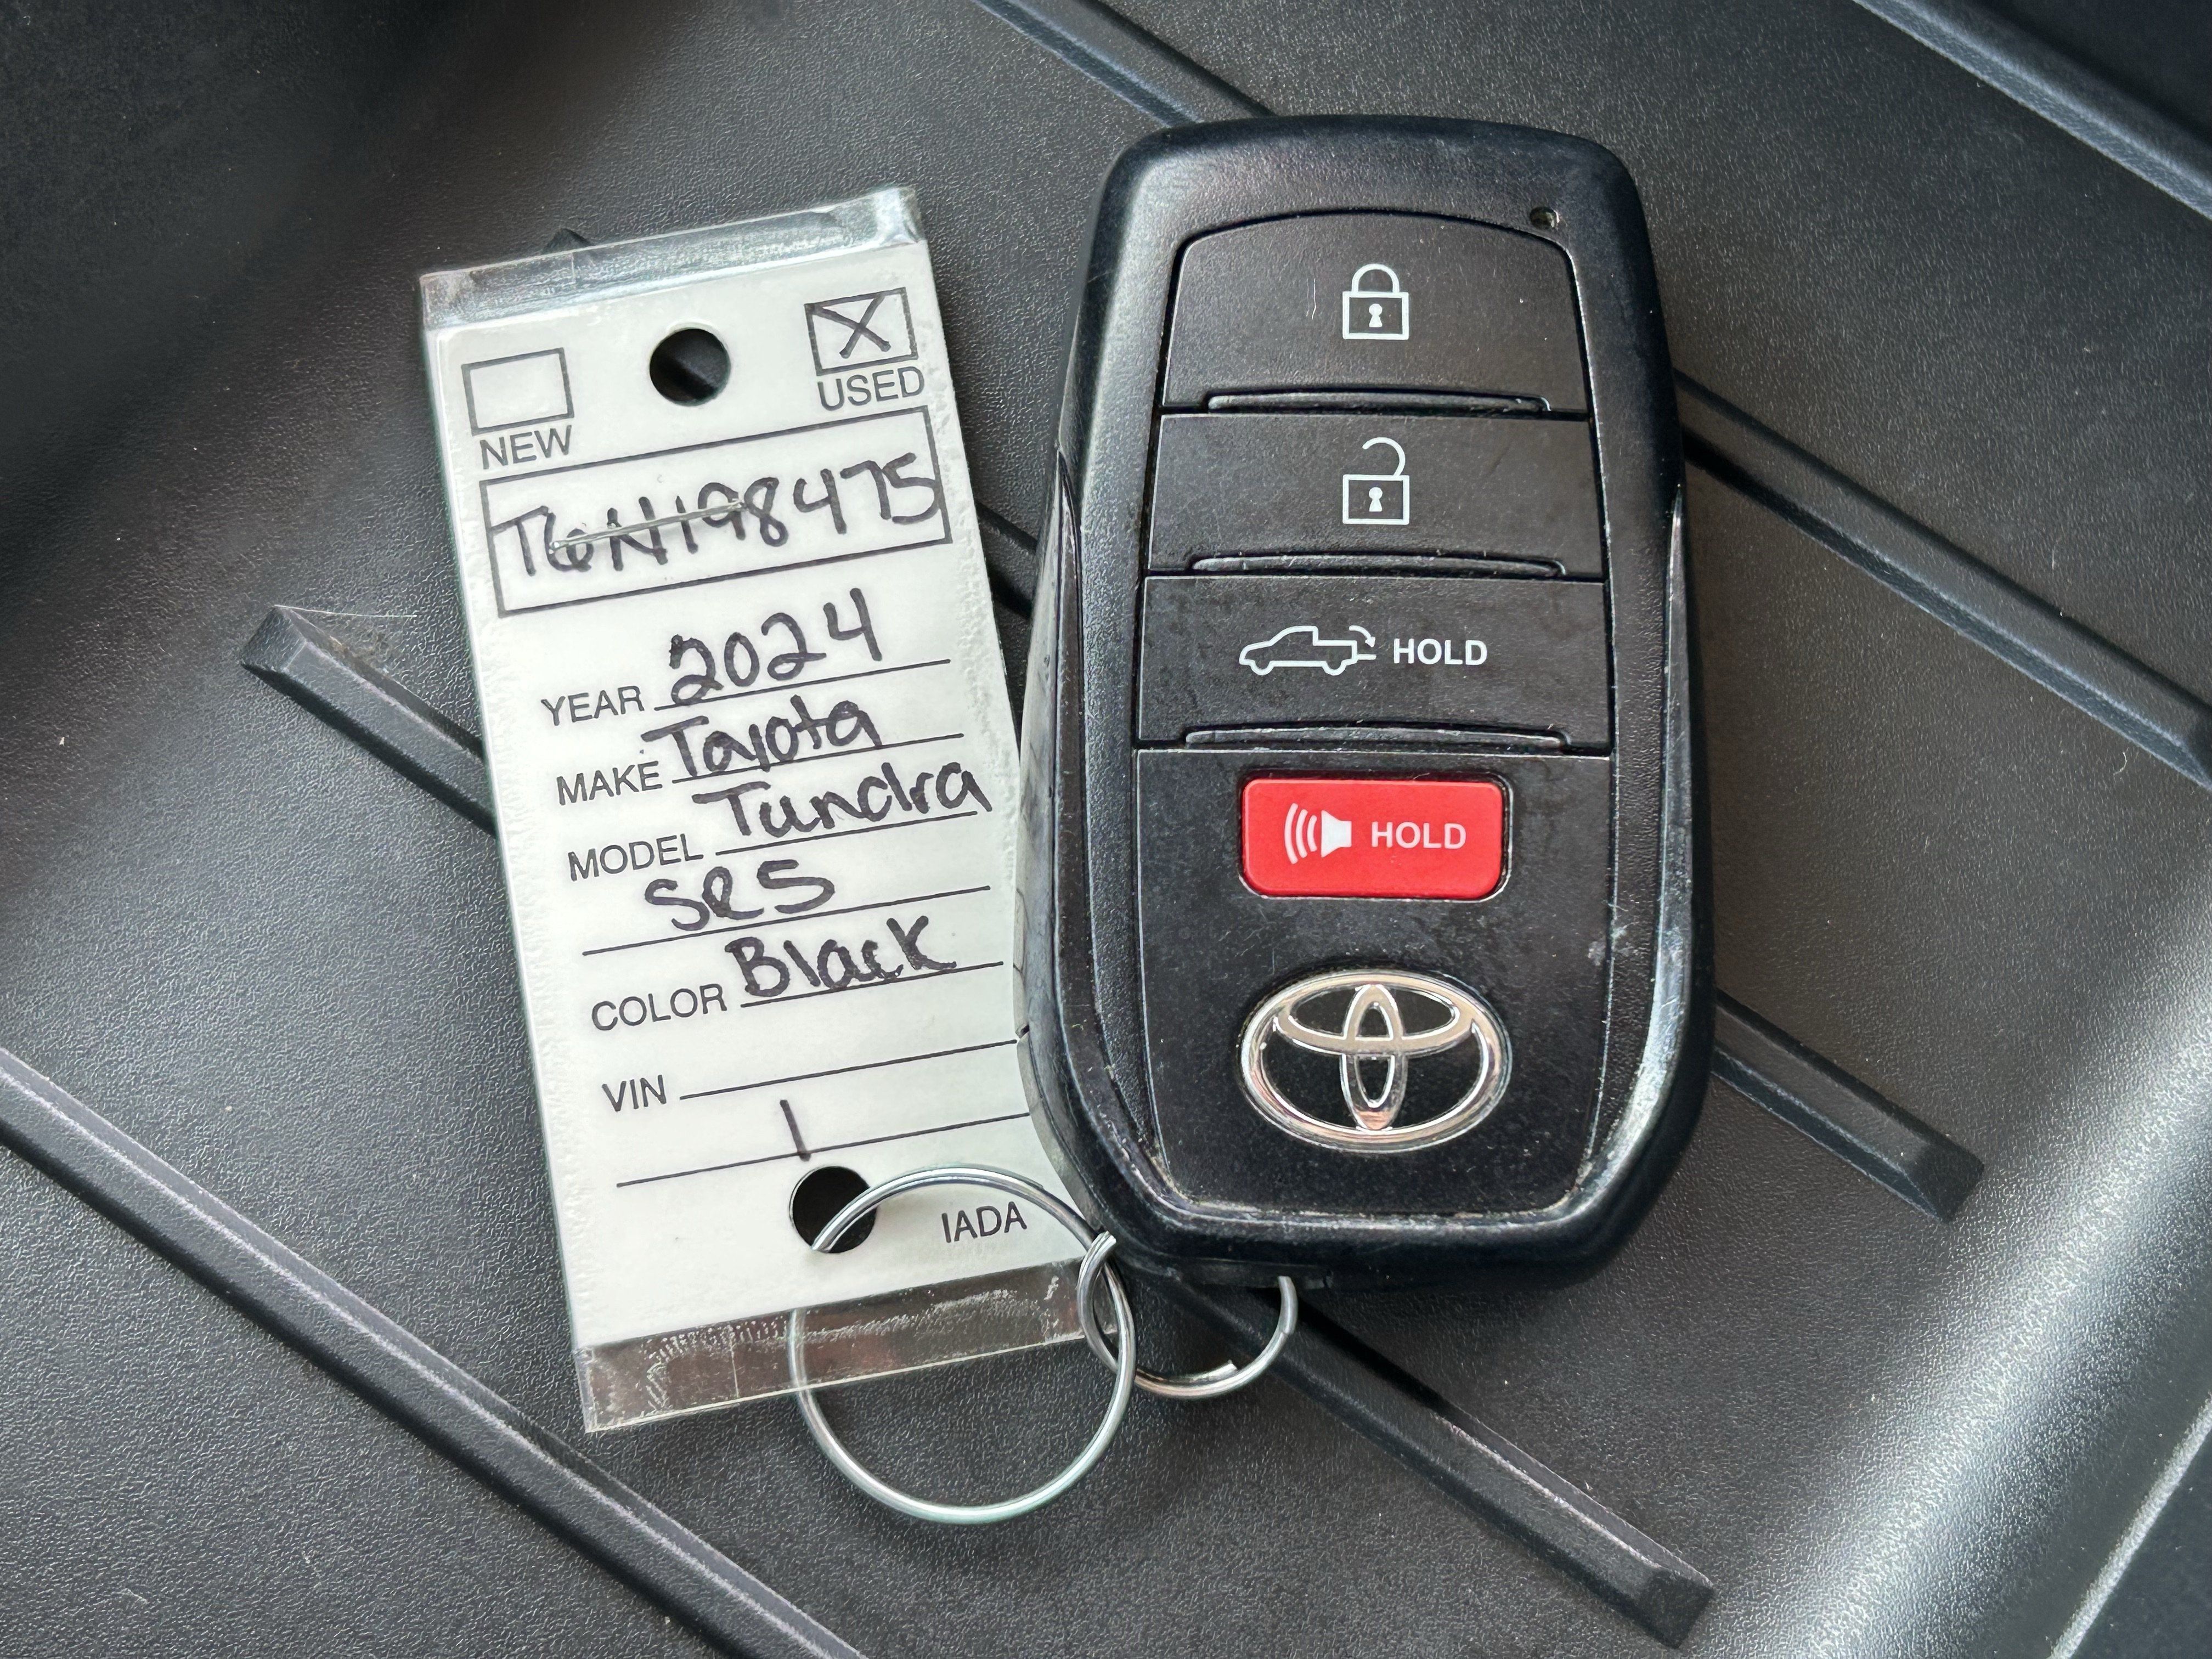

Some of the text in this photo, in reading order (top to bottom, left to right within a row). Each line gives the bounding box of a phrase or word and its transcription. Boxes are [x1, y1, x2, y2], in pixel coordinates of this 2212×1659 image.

[816, 366, 925, 412] USED
[479, 425, 573, 470] NEW
[668, 588, 883, 706] 2024
[1393, 638, 1487, 666] HOLD
[540, 685, 645, 727] YEAR
[556, 761, 663, 806] MAKE
[691, 763, 992, 838] Tundra
[567, 833, 705, 881] MODEL
[1371, 821, 1466, 850] HOLD
[725, 915, 957, 998] Black
[591, 983, 728, 1031] COLOR
[601, 1074, 668, 1112] VIN
[941, 1201, 1028, 1244] IADA
